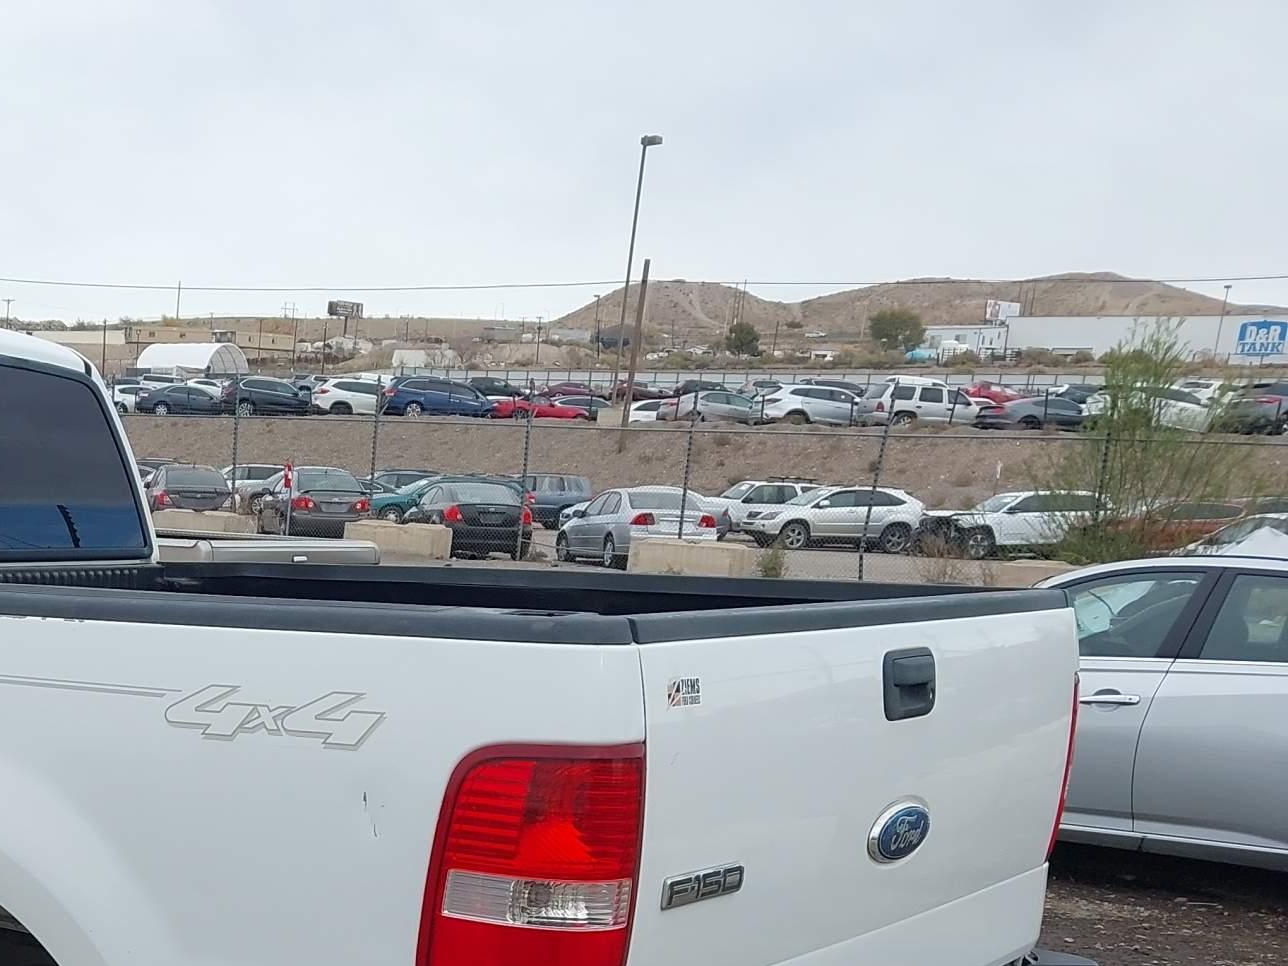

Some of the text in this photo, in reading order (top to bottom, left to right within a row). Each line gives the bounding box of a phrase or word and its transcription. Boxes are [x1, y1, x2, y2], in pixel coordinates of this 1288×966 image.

[1244, 325, 1281, 342] D&R
[1239, 341, 1282, 353] TANK
[890, 814, 925, 851] Ford
